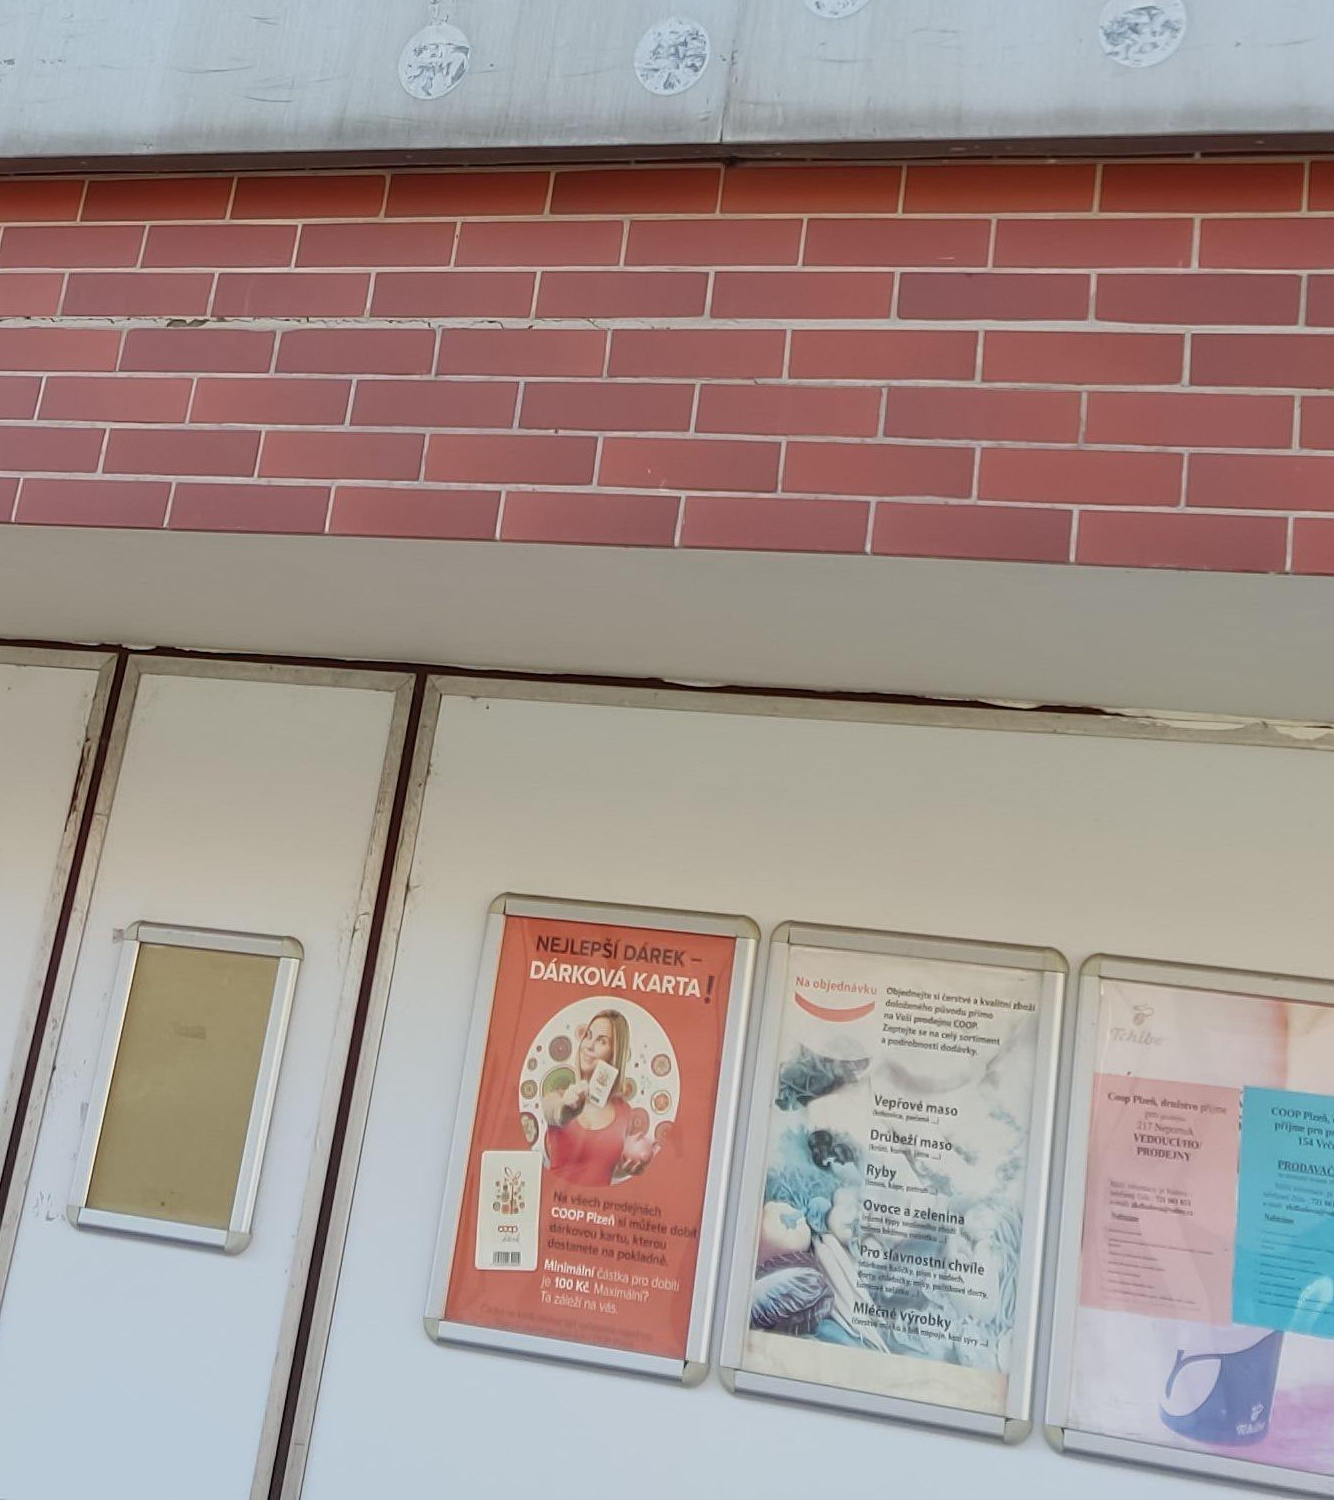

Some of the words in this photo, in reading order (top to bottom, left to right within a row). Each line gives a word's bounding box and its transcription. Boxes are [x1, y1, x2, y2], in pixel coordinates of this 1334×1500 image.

[537, 935, 621, 960] NEJLEPŠÍ
[624, 942, 685, 967] DÁREK
[530, 958, 627, 989] DÁRKOVÁ
[795, 976, 810, 987] Na
[813, 978, 877, 995] objednávku
[887, 987, 931, 1000] Objednejte
[935, 1005, 966, 1016] původu
[887, 1036, 938, 1050] podrobnosti
[929, 1030, 939, 1038] na
[959, 1034, 1000, 1045] sortiment
[874, 1094, 923, 1111] Vepřové
[926, 1104, 958, 1116] maso
[1108, 1092, 1130, 1104] Coop
[1271, 1107, 1302, 1119] COOP
[870, 1129, 918, 1146] Drůbeží
[920, 1138, 953, 1151] maso
[1307, 1126, 1323, 1137] pro
[1137, 1147, 1191, 1161] PRODEJNY
[867, 1164, 896, 1181] Ryby
[553, 1191, 567, 1202] Na
[570, 1191, 600, 1208] všech
[603, 1200, 661, 1217] prodejnách
[863, 1199, 901, 1215] Ovoce
[904, 1206, 911, 1216] a
[913, 1208, 965, 1225] zelenina
[551, 1207, 584, 1220] COOP
[586, 1211, 615, 1226] Plzeň
[547, 1238, 600, 1255] dostanete
[601, 1248, 614, 1258] na
[632, 1235, 667, 1249] kterou
[860, 1245, 880, 1258] Pro
[883, 1249, 946, 1269] slavnostní
[948, 1260, 984, 1275] chvíle
[544, 1259, 595, 1277] Minimální
[631, 1275, 649, 1288] pro
[555, 1277, 574, 1291] 100
[584, 1300, 596, 1311] na
[853, 1301, 897, 1319] Mléčné
[900, 1310, 951, 1331] výrobky
